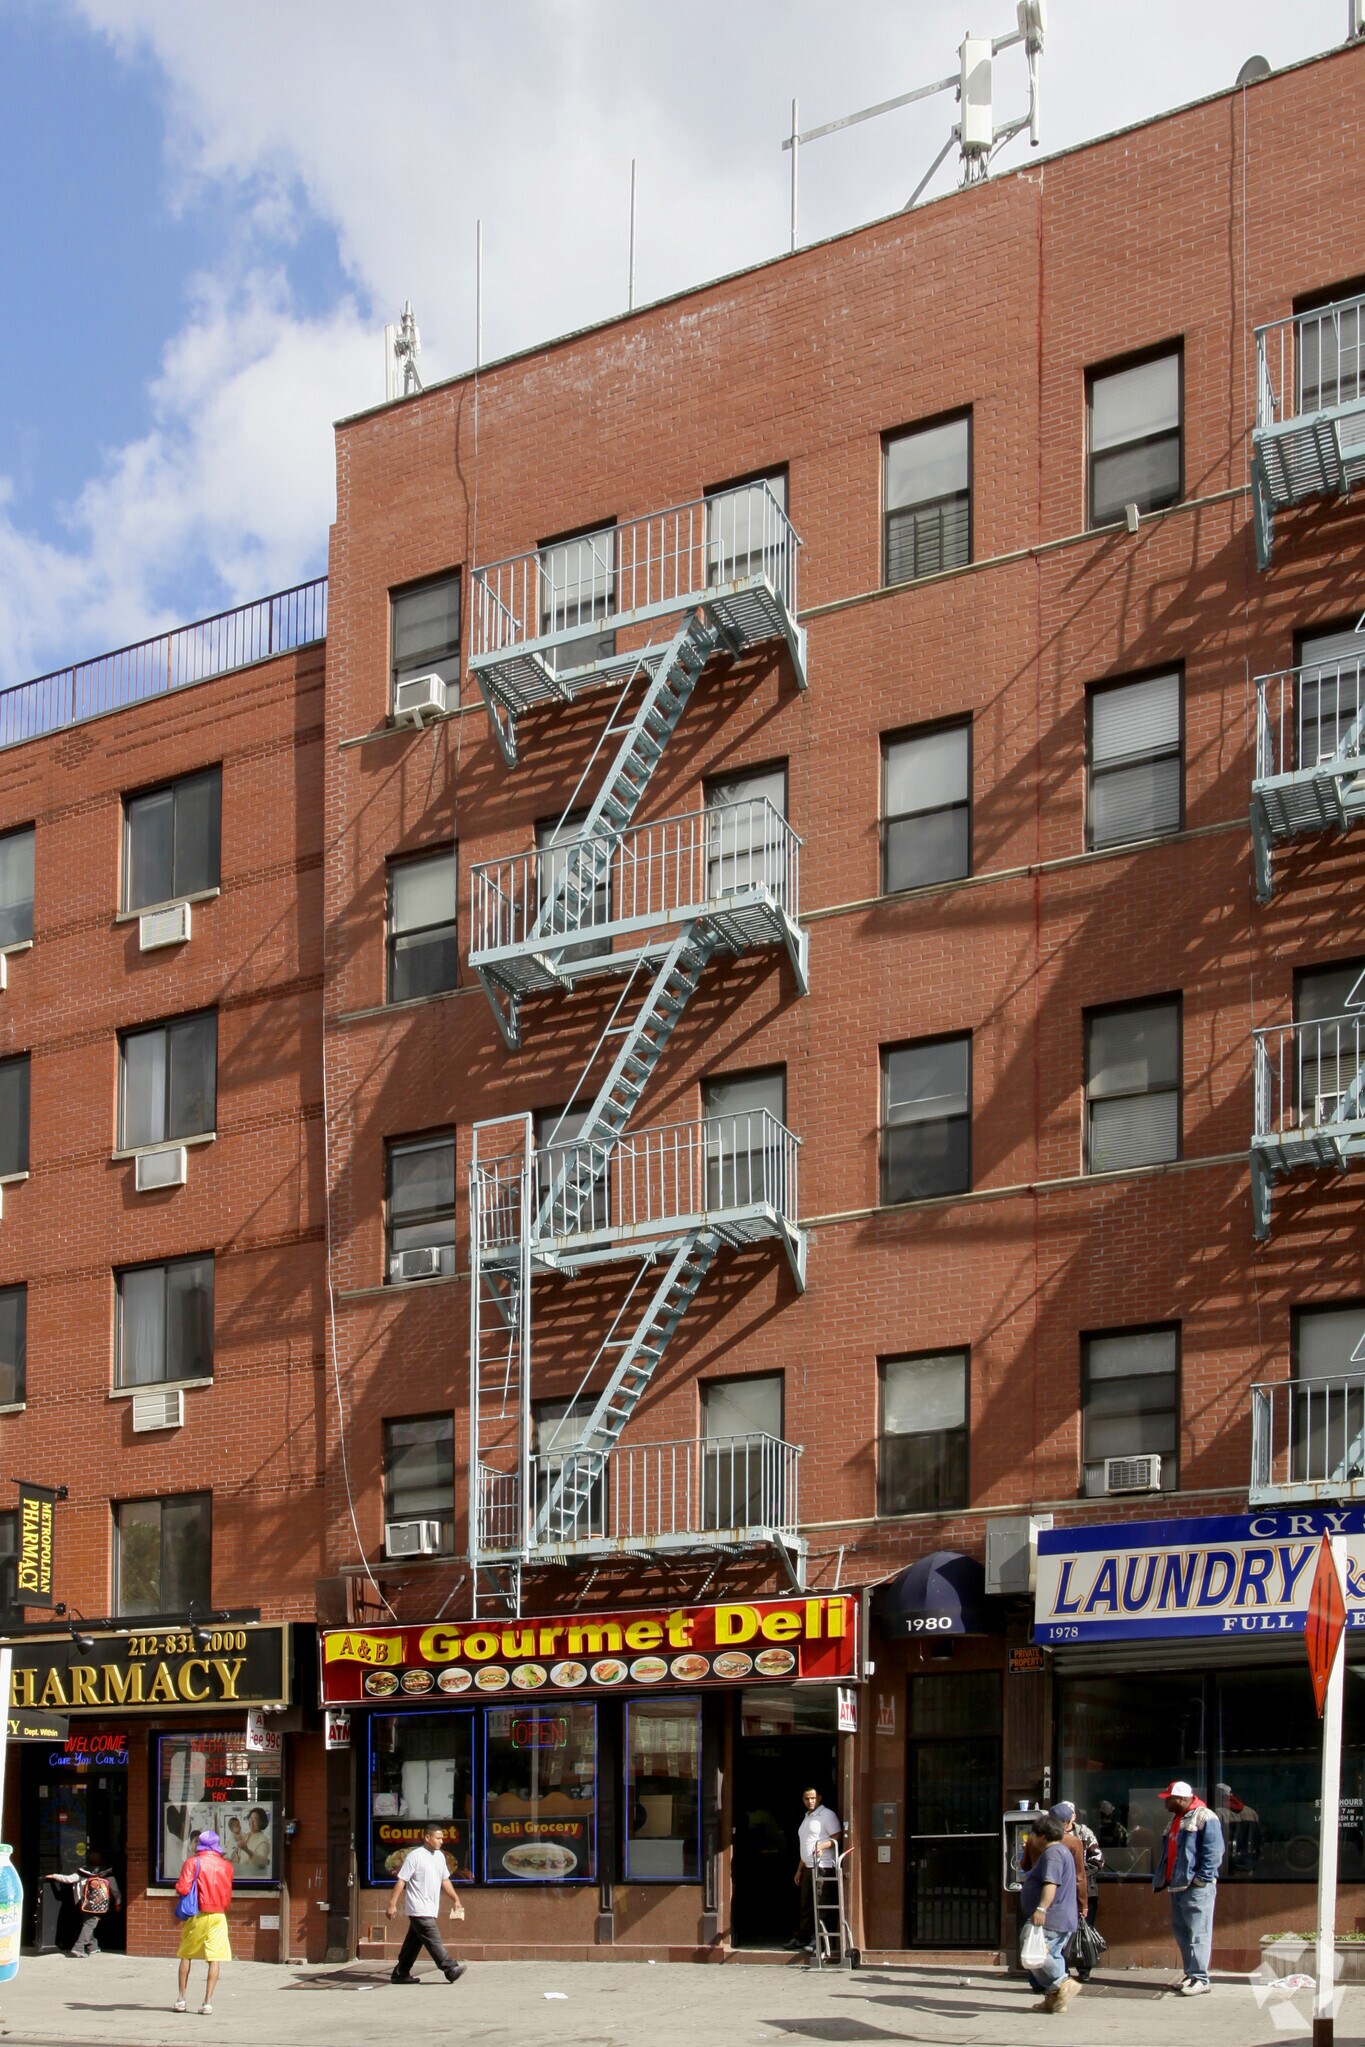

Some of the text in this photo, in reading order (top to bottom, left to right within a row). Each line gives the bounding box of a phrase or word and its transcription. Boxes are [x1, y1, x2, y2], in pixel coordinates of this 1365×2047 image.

[1249, 1512, 1365, 1538] CRY
[22, 1498, 40, 1592] PHARMACY
[41, 1502, 52, 1593] METROPOLITAN
[1051, 1543, 1319, 1615] LAUNDRY
[419, 1598, 847, 1662] Gourmet Deli
[906, 1617, 952, 1631] 1980
[1222, 1615, 1293, 1631] FULL
[1049, 1627, 1078, 1639] 1978
[128, 1631, 246, 1656] 212-8311000
[340, 1635, 388, 1662] A & B
[1014, 1648, 1040, 1658] PRIVATE
[1010, 1656, 1044, 1667] PROPERTY
[24, 1728, 39, 1737] Dept.
[40, 1729, 58, 1737] Within
[516, 1722, 563, 1744] OPEN
[64, 1735, 127, 1752] WELCOME
[49, 1753, 71, 1766] Care
[74, 1752, 92, 1766] You
[95, 1752, 115, 1765] Can
[204, 1777, 235, 1788] NOTARY
[211, 1792, 227, 1802] FAX
[379, 1824, 457, 1840] Gouret
[492, 1821, 579, 1835] Deli Grocery
